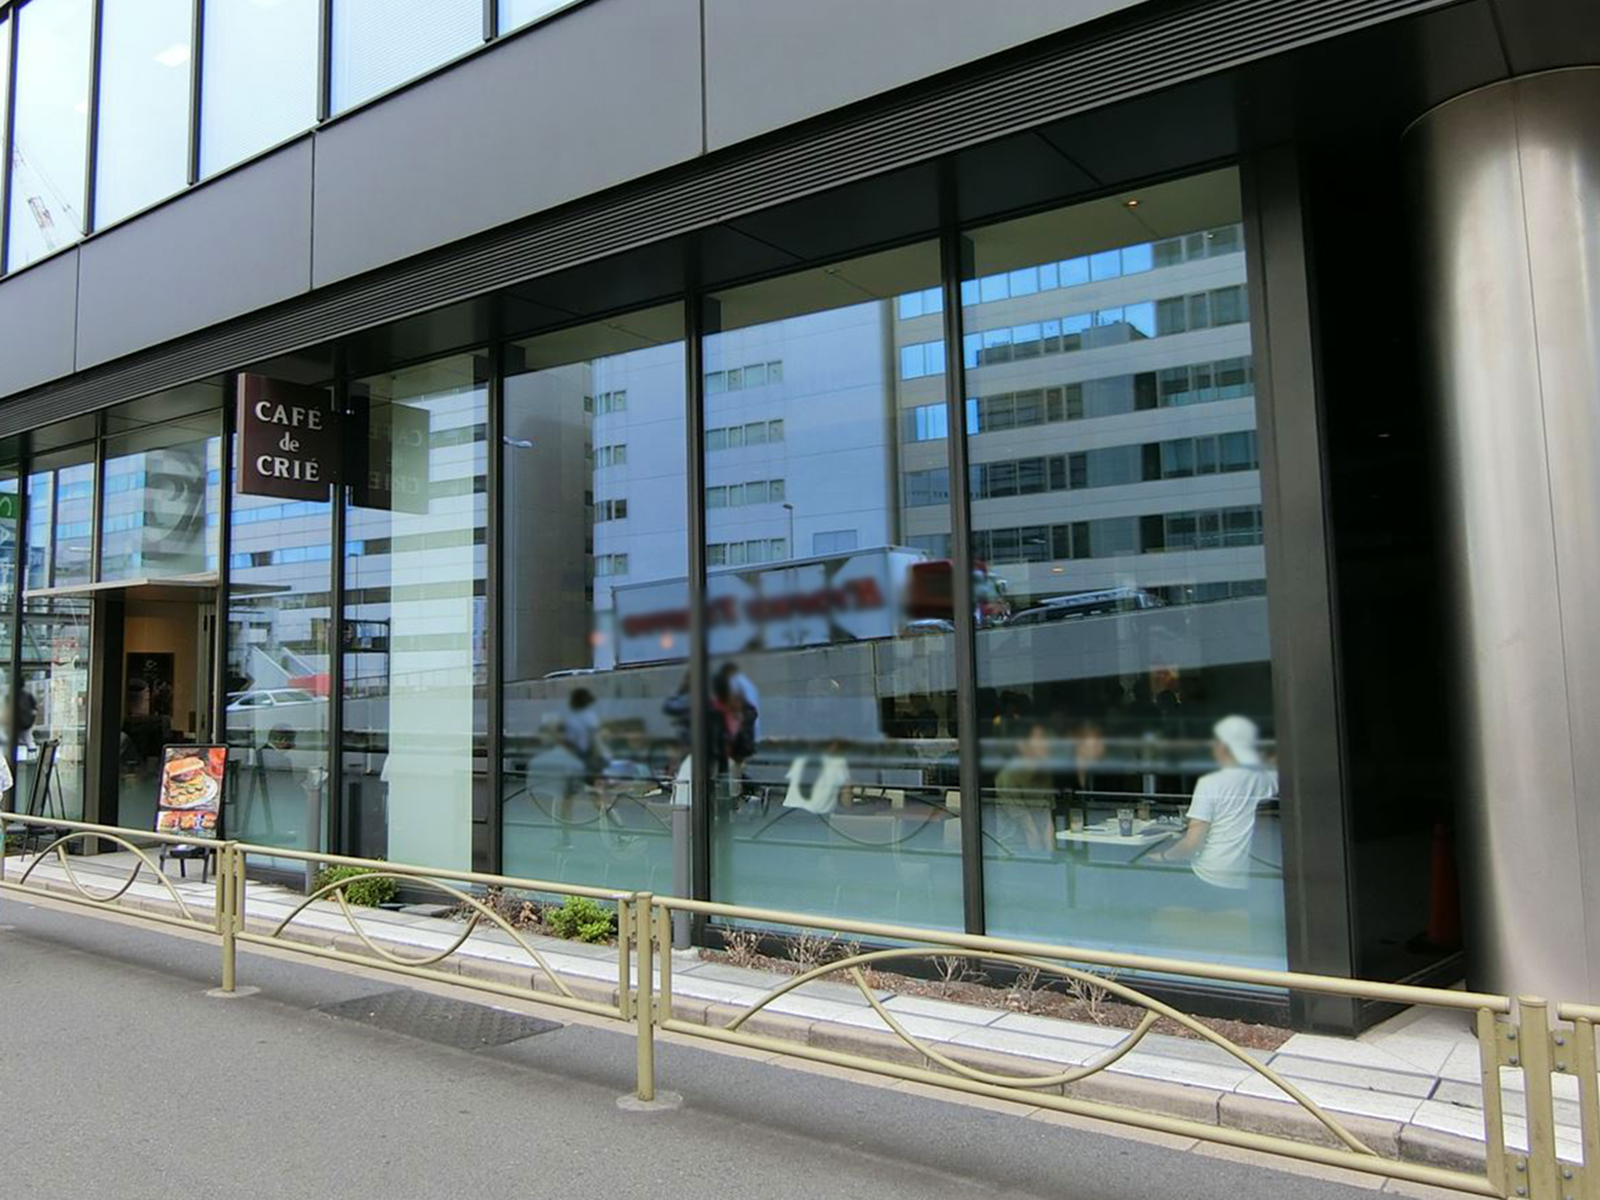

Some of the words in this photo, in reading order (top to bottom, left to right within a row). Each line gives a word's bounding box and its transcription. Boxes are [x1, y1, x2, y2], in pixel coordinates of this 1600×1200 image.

[255, 401, 323, 430] CAFÉ
[279, 432, 300, 452] de
[256, 456, 320, 481] CRIÉ
